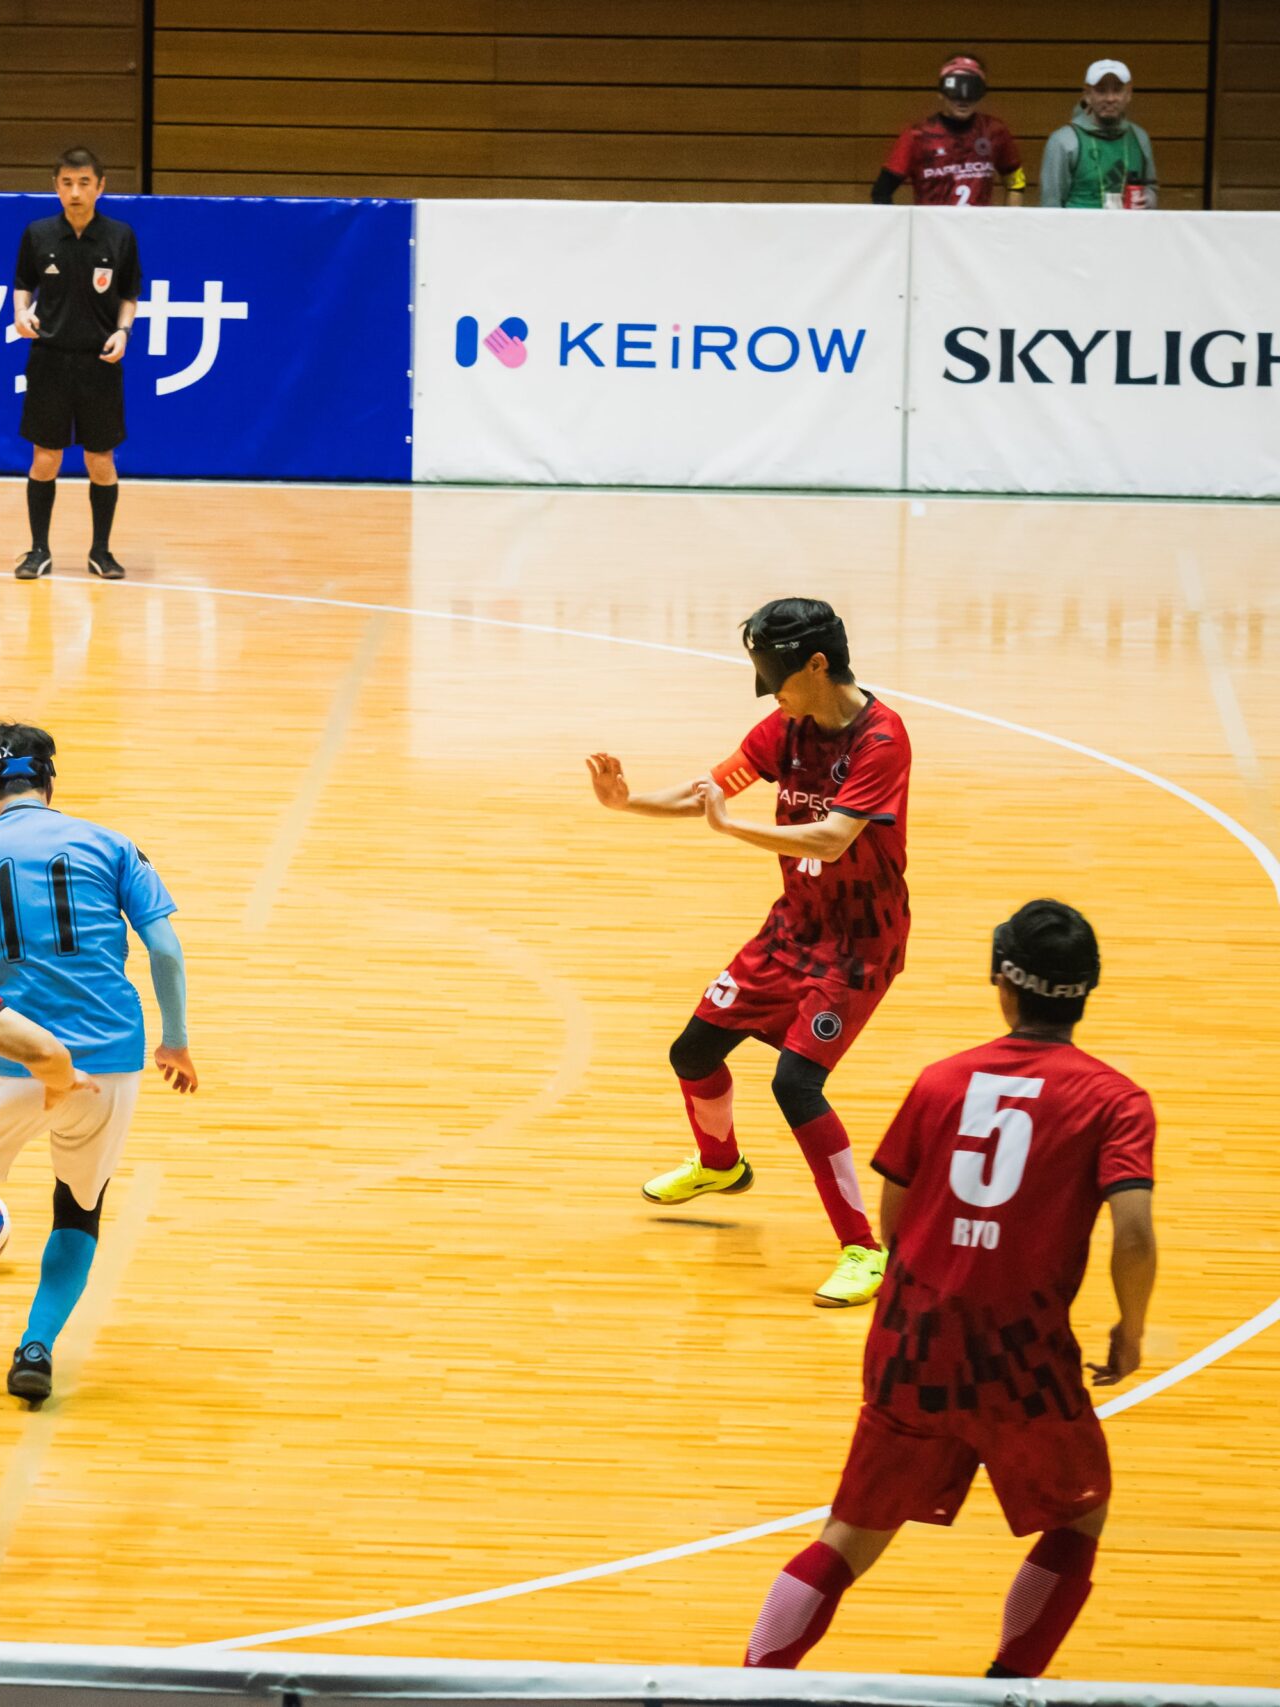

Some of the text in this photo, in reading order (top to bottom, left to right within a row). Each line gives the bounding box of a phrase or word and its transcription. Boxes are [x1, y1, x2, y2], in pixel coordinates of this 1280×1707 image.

[955, 185, 972, 206] 2
[949, 1071, 1046, 1208] 5
[951, 1217, 1001, 1250] RYO
